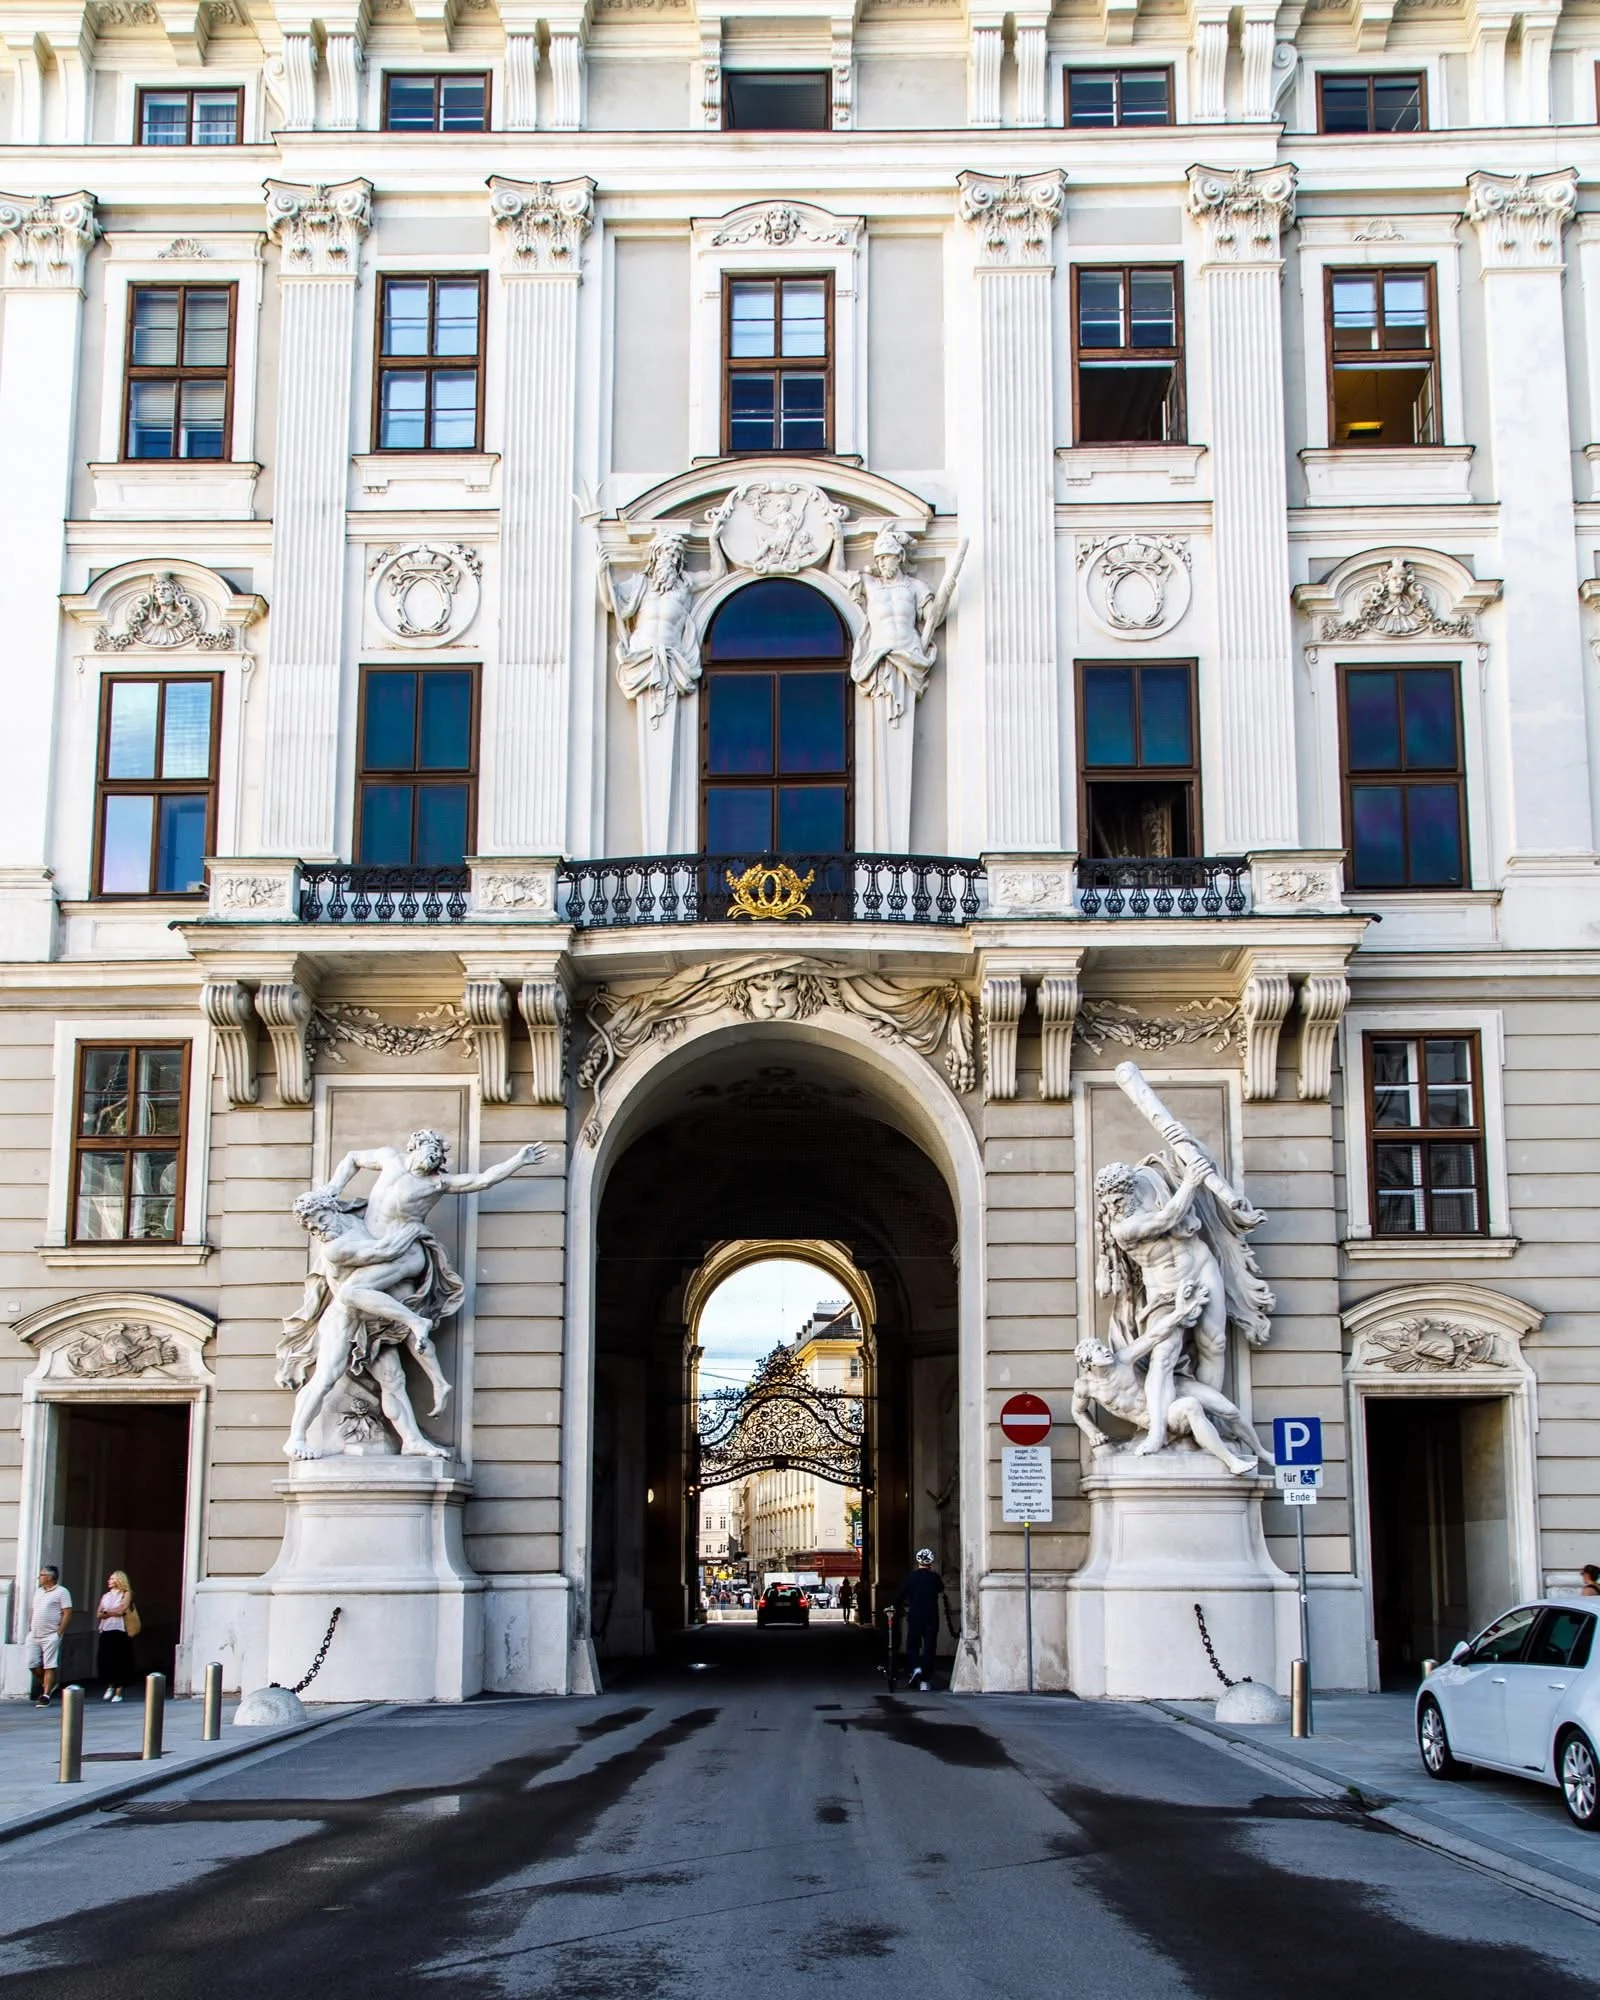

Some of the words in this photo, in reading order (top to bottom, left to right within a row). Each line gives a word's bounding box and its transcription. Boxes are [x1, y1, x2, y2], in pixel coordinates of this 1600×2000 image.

[1284, 1422, 1311, 1461] P
[1283, 1472, 1297, 1483] für
[1290, 1492, 1311, 1502] Ende
